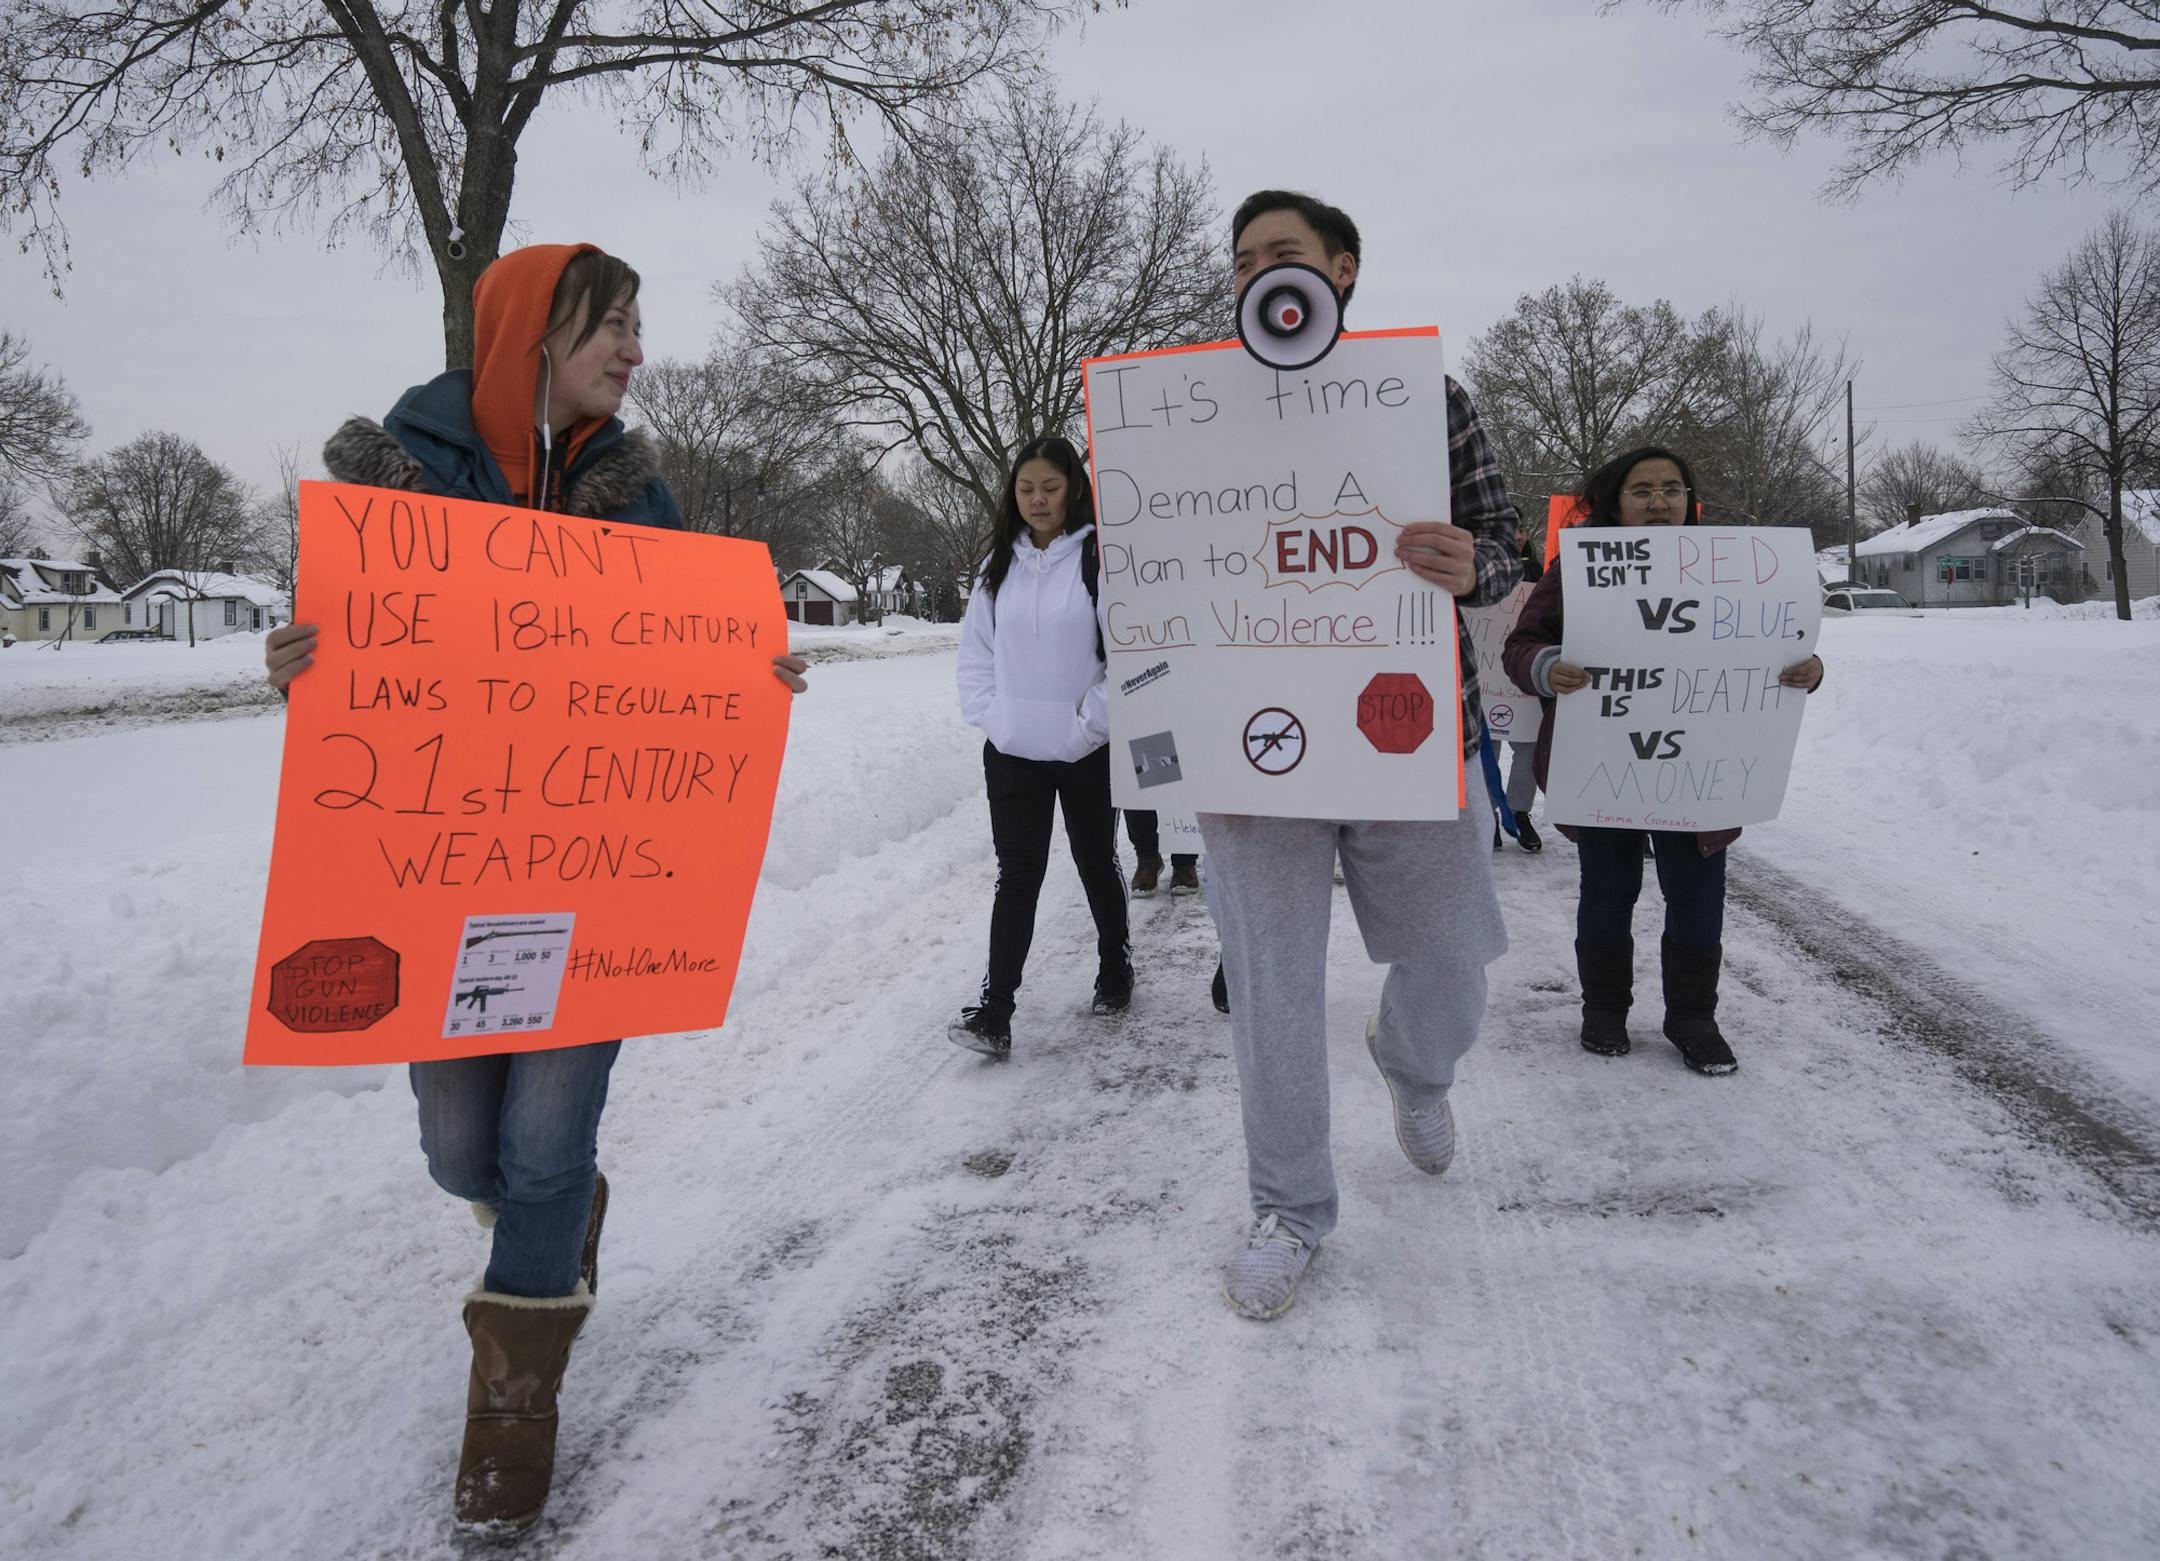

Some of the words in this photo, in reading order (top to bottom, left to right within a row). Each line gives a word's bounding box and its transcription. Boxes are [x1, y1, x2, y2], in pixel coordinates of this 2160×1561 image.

[1095, 366, 1218, 433] It's
[1266, 368, 1410, 420] time
[1097, 469, 1298, 526] Demand
[1334, 471, 1368, 506] A
[334, 496, 450, 573] YOU
[486, 515, 659, 584] CAN'T
[1102, 543, 1184, 585] Plan
[1204, 543, 1248, 578] to
[1276, 526, 1378, 575] END
[1578, 538, 1651, 563] THIS
[1678, 535, 1779, 586] RED
[1586, 563, 1652, 588] ISN'T
[347, 591, 437, 649] USE
[494, 600, 589, 653] 18th
[611, 614, 760, 647] CENTURY
[1107, 602, 1191, 647] Gun
[1211, 597, 1377, 644] Violence
[1636, 597, 1700, 634] VS
[1712, 596, 1805, 641] BLUE,
[349, 670, 448, 712] LAWS
[478, 678, 536, 714] TO
[568, 681, 741, 721] REGULATE
[1121, 660, 1169, 692] #NeverAgain
[1584, 667, 1665, 690] THIS
[1672, 667, 1785, 714] DEATH
[1359, 693, 1426, 723] STOP
[1601, 695, 1630, 718] IS
[1628, 731, 1686, 760] VS
[314, 733, 522, 816] 21st
[541, 745, 748, 807] CENTURY
[1578, 758, 1758, 803] MONEY
[378, 833, 675, 889] WEAPONS.
[282, 954, 365, 979] STOP
[514, 951, 537, 962] 1,000
[541, 951, 551, 960] 50
[567, 946, 720, 984] #NotOneMore
[295, 978, 357, 998] GUN
[284, 1003, 385, 1024] VIOLENCE
[450, 1022, 460, 1031] 30
